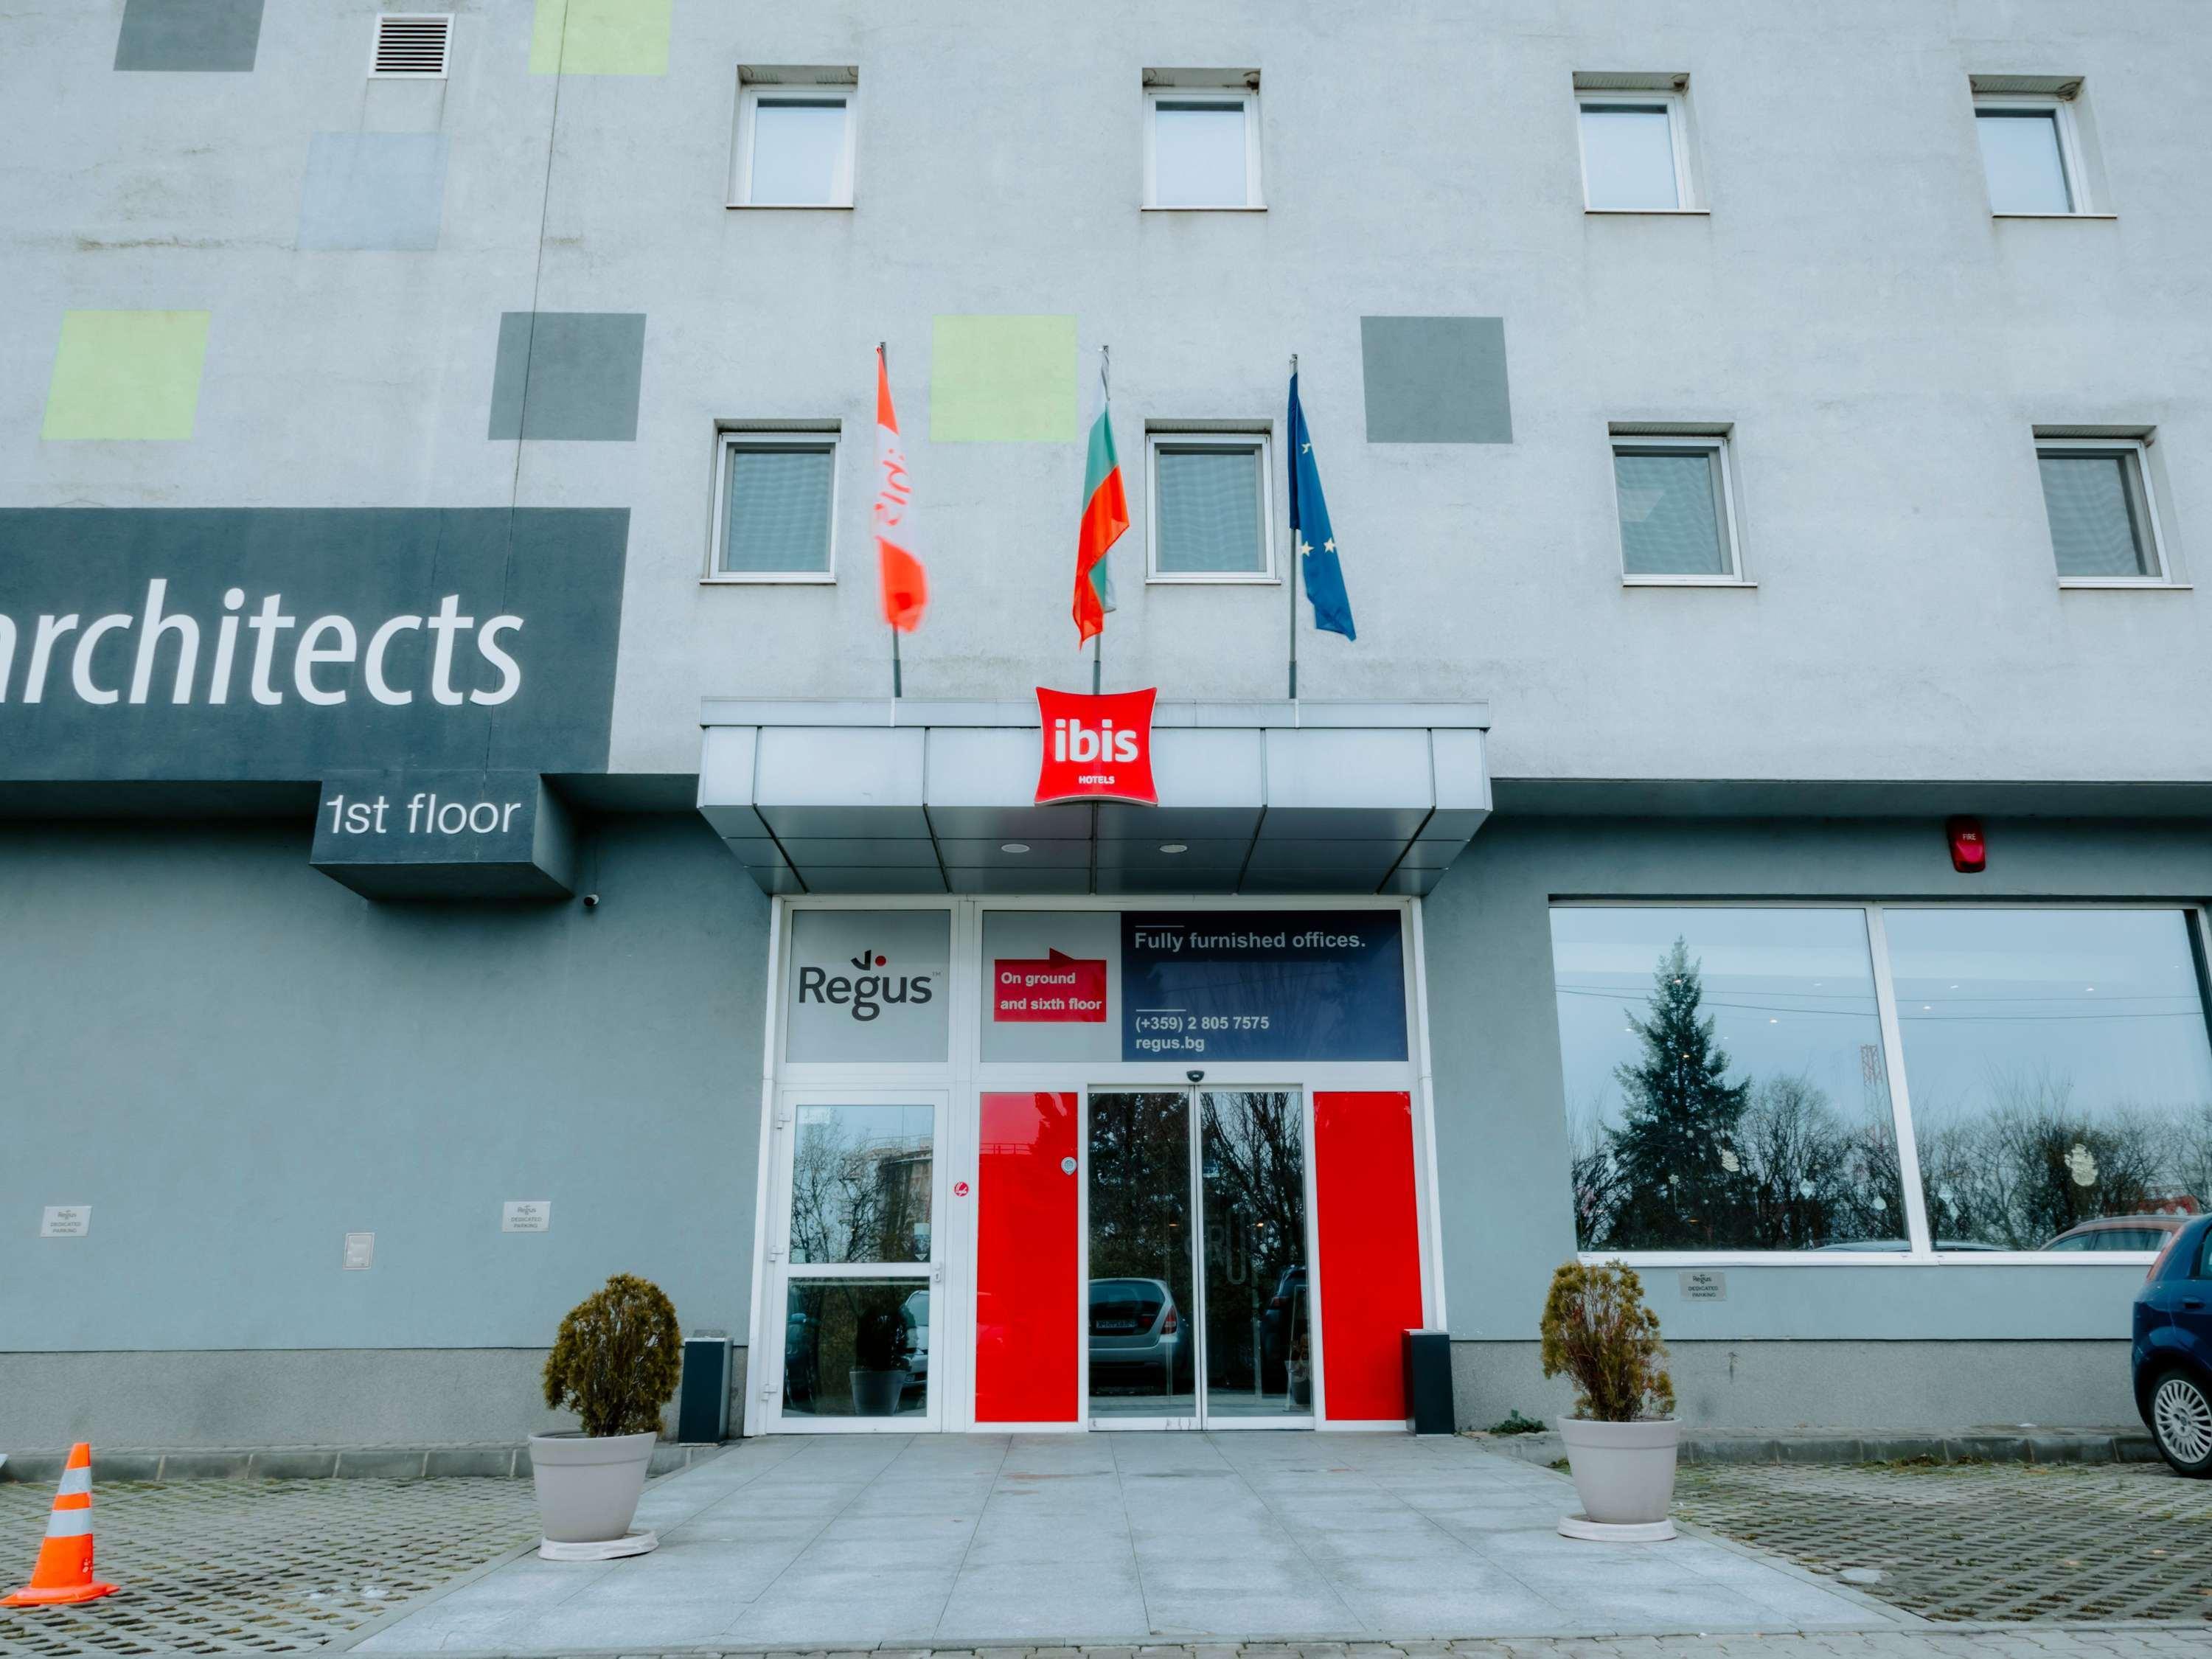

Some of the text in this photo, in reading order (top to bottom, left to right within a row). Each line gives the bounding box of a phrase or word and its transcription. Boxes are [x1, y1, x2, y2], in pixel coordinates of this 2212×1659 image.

[0, 578, 524, 706] rchitects
[1054, 718, 1138, 763] ibis
[1078, 775, 1116, 785] HOTELS
[326, 793, 522, 834] 1st floor
[1135, 932, 1366, 952] Fully furnished offices.
[1001, 972, 1077, 987] On ground
[799, 967, 933, 1021] Regus
[1000, 998, 1103, 1010] and sixth floor
[1135, 1016, 1270, 1033] (+359) 2 805 7575
[1135, 1036, 1206, 1053] regus.bg
